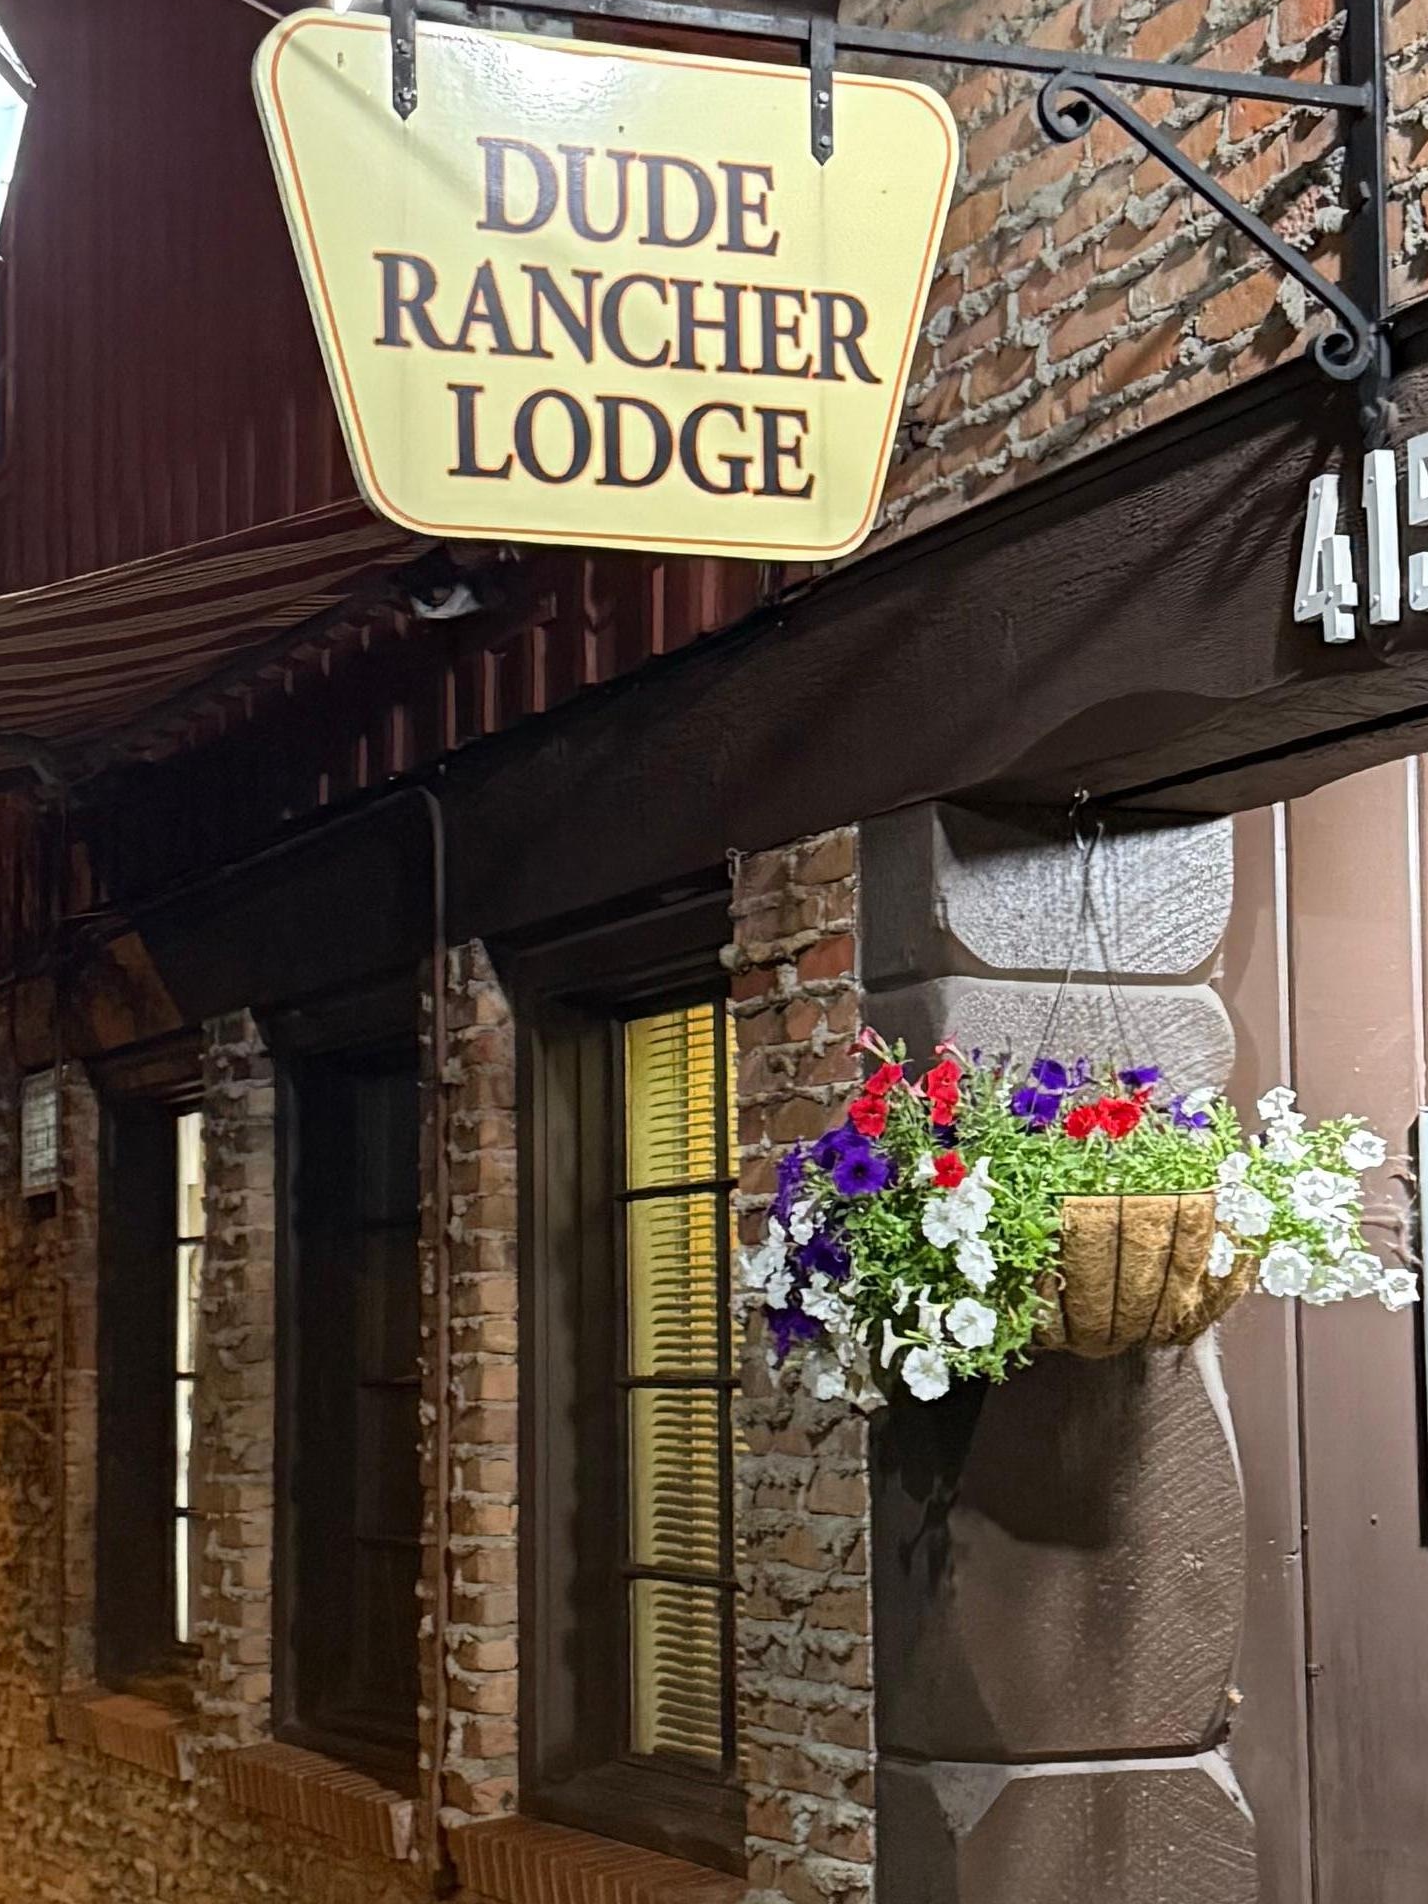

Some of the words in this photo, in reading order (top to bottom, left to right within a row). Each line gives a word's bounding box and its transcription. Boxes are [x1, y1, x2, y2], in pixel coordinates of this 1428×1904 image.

[475, 135, 781, 258] DUDE
[372, 251, 883, 385] RANCHER
[446, 381, 816, 500] LODGE
